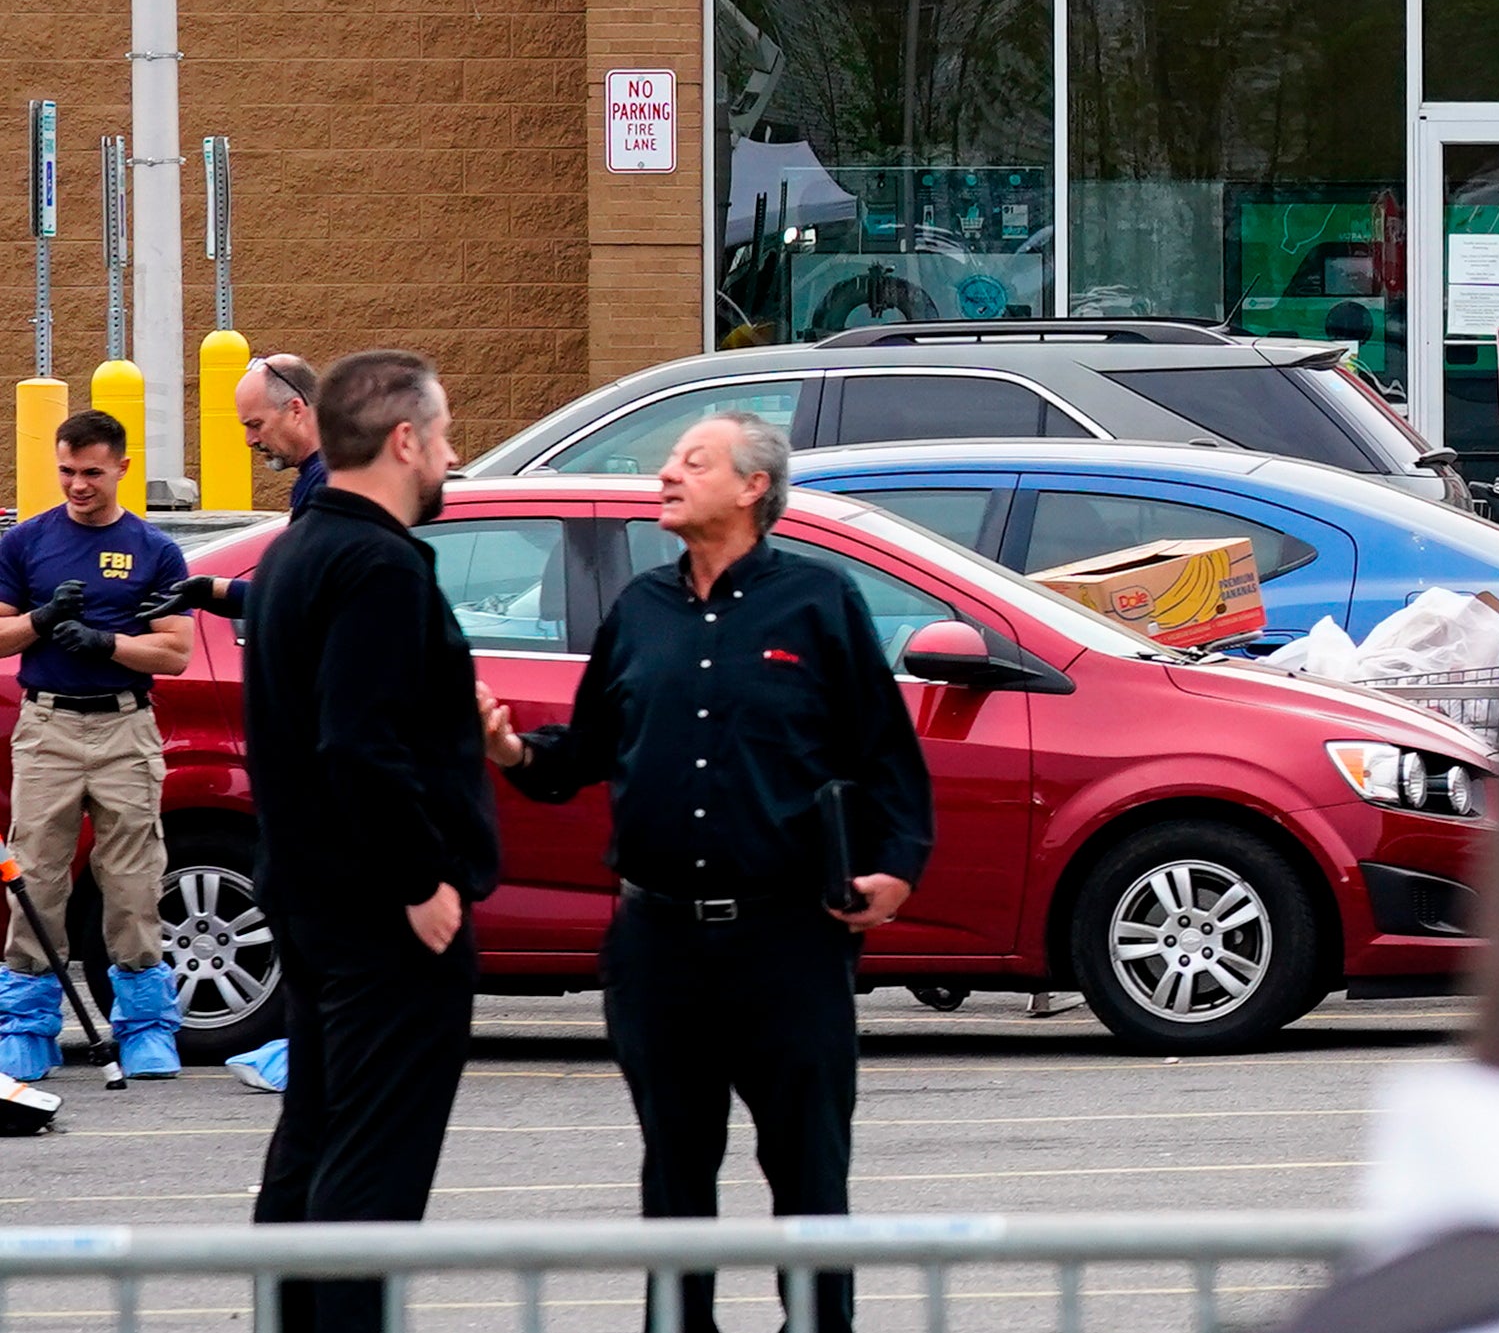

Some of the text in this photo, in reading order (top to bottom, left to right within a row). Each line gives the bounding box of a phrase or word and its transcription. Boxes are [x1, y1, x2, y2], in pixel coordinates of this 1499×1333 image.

[629, 80, 653, 98] NO
[612, 102, 670, 120] PARKING
[627, 123, 655, 136] FIRE
[625, 138, 657, 151] LANE
[99, 551, 133, 570] FBI
[1118, 591, 1148, 609] Dole
